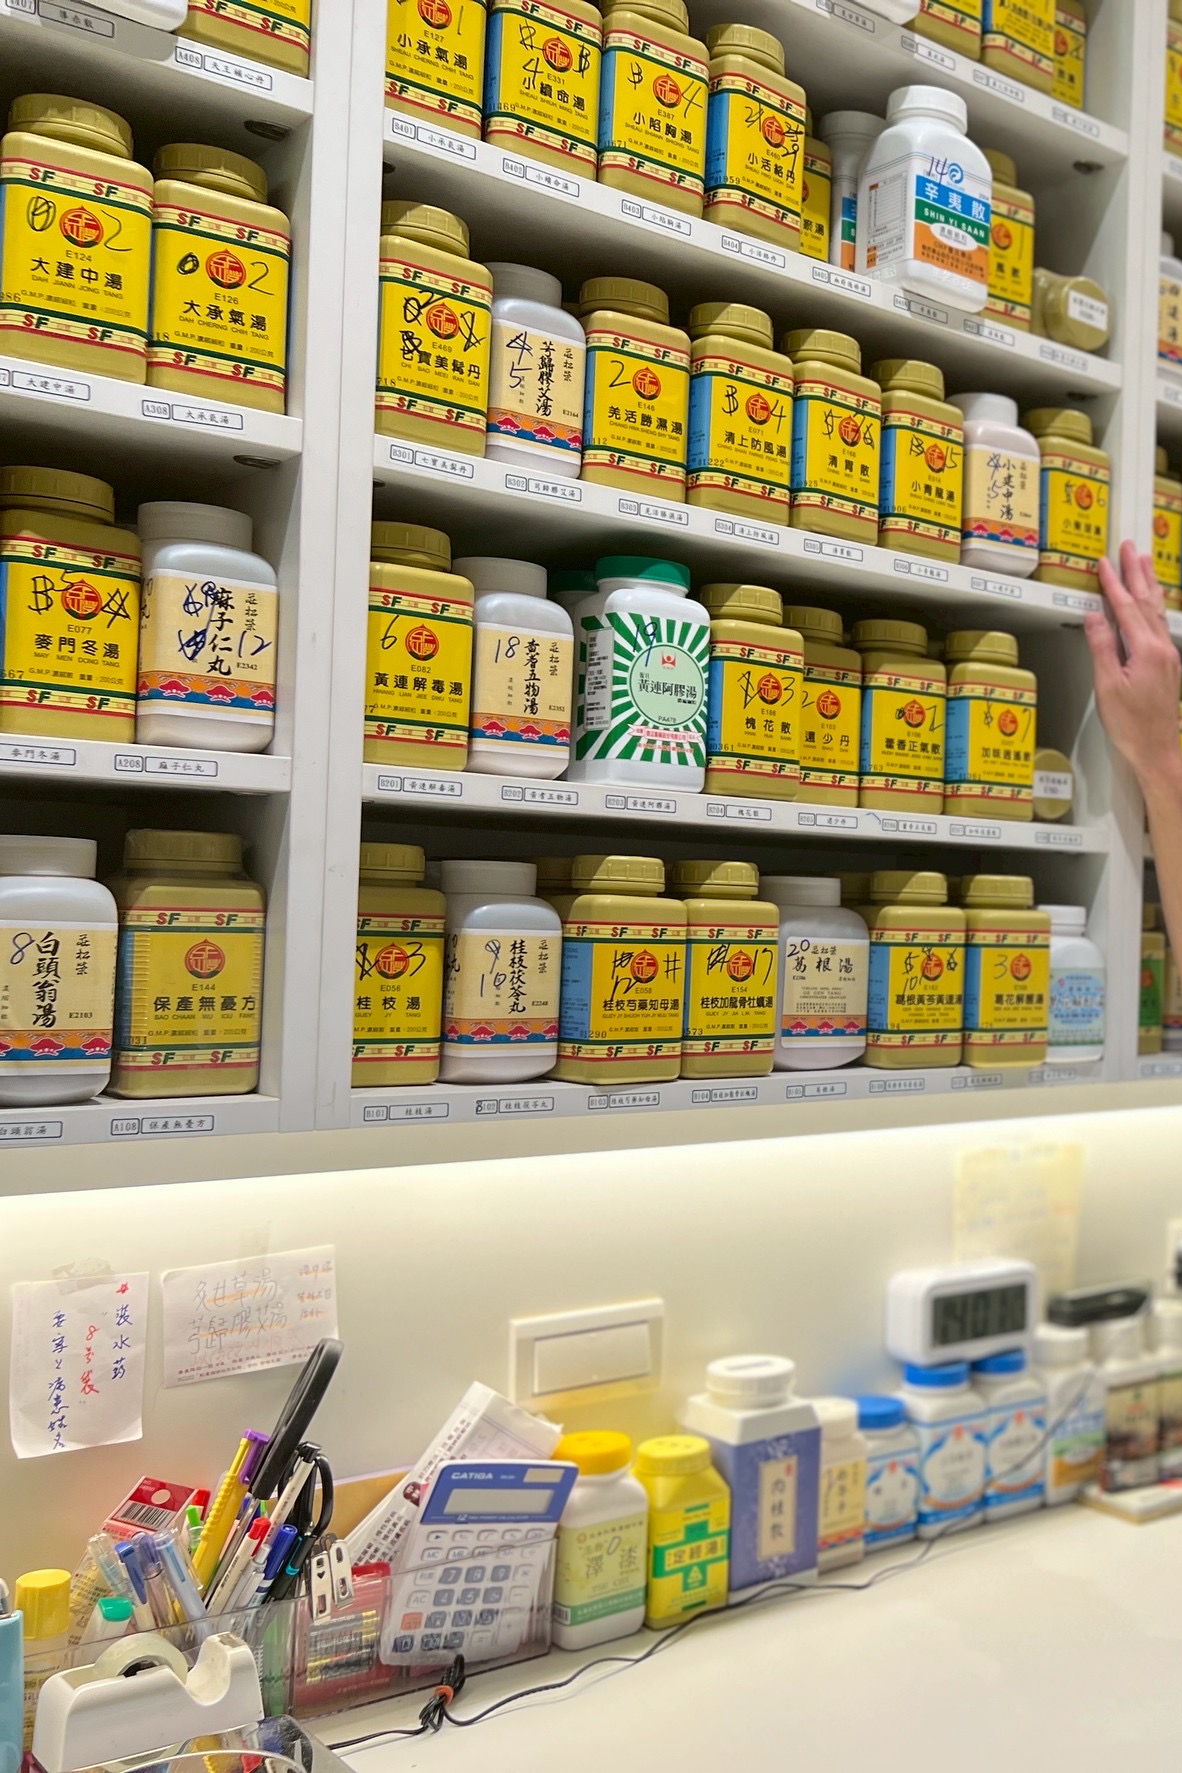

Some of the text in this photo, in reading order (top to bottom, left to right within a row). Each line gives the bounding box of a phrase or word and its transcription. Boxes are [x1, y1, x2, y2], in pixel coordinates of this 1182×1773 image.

[261, 17, 283, 32] SF
[521, 0, 583, 32] SF SF
[424, 30, 444, 43] E127
[397, 33, 468, 70] 小承氣湯
[633, 40, 691, 69] SF SF
[547, 72, 566, 85] E331
[389, 81, 459, 113] SF SF
[522, 77, 585, 111] 小續命湯
[745, 82, 793, 111] SF SF
[658, 109, 675, 120] E387
[633, 112, 692, 145] 小陷胸湯
[29, 167, 119, 198] SF SF
[924, 183, 986, 221] 辛夷散
[178, 213, 259, 241] SF SF
[924, 207, 985, 238] SHIN YI SAAN
[65, 249, 92, 263] E124
[30, 257, 123, 291] 大建中湯
[402, 267, 471, 296] SF SF
[214, 292, 239, 305] E126
[183, 300, 267, 332] 大承氣湯
[432, 341, 453, 354] E469
[612, 336, 671, 361] SF SF
[609, 360, 631, 388] 2
[728, 363, 780, 387] SF SF
[638, 401, 655, 412] E146
[824, 387, 869, 410] SF SF
[724, 430, 787, 459] 清上防風湯
[828, 454, 870, 478] 清胃散
[911, 480, 955, 503] 小青龍湯
[1000, 458, 1017, 521] 小建中湯
[907, 521, 950, 540] SF SF
[32, 545, 116, 569] SF SF
[381, 594, 450, 615] SF SF
[67, 624, 92, 635] E077
[380, 615, 400, 650] 6
[35, 633, 120, 660] 麥門冬湯
[494, 636, 520, 663] 18
[633, 622, 658, 668] 19
[740, 648, 790, 664] SF SF
[411, 664, 432, 674] E082
[523, 638, 541, 717] 黃耆五物湯
[835, 672, 849, 681] SF
[374, 672, 463, 696] 黃連解毒湯
[637, 679, 698, 700] 黃連阿膠湯
[745, 717, 791, 735] 槐花散
[805, 731, 850, 747] 還少丹
[885, 738, 941, 755] 藿香正氣散
[156, 912, 239, 927] SF SF
[401, 919, 421, 931] SF
[611, 926, 668, 938] SF SF
[708, 928, 763, 939] SF SF
[10, 933, 35, 966] 8
[792, 956, 854, 973] 葛根湯
[32, 932, 62, 1028] 白頭翁湯
[192, 984, 216, 992] E144
[380, 984, 401, 992] E056
[508, 939, 528, 1015] 桂枝茯苓丸
[153, 995, 257, 1012] 保產無憂方
[357, 996, 421, 1011] 桂枝湯
[603, 999, 679, 1012] 桂枝芍藥知母湯
[700, 995, 773, 1009] 桂枝加龍骨牡蠣湯
[451, 1472, 493, 1480] CATIGA
